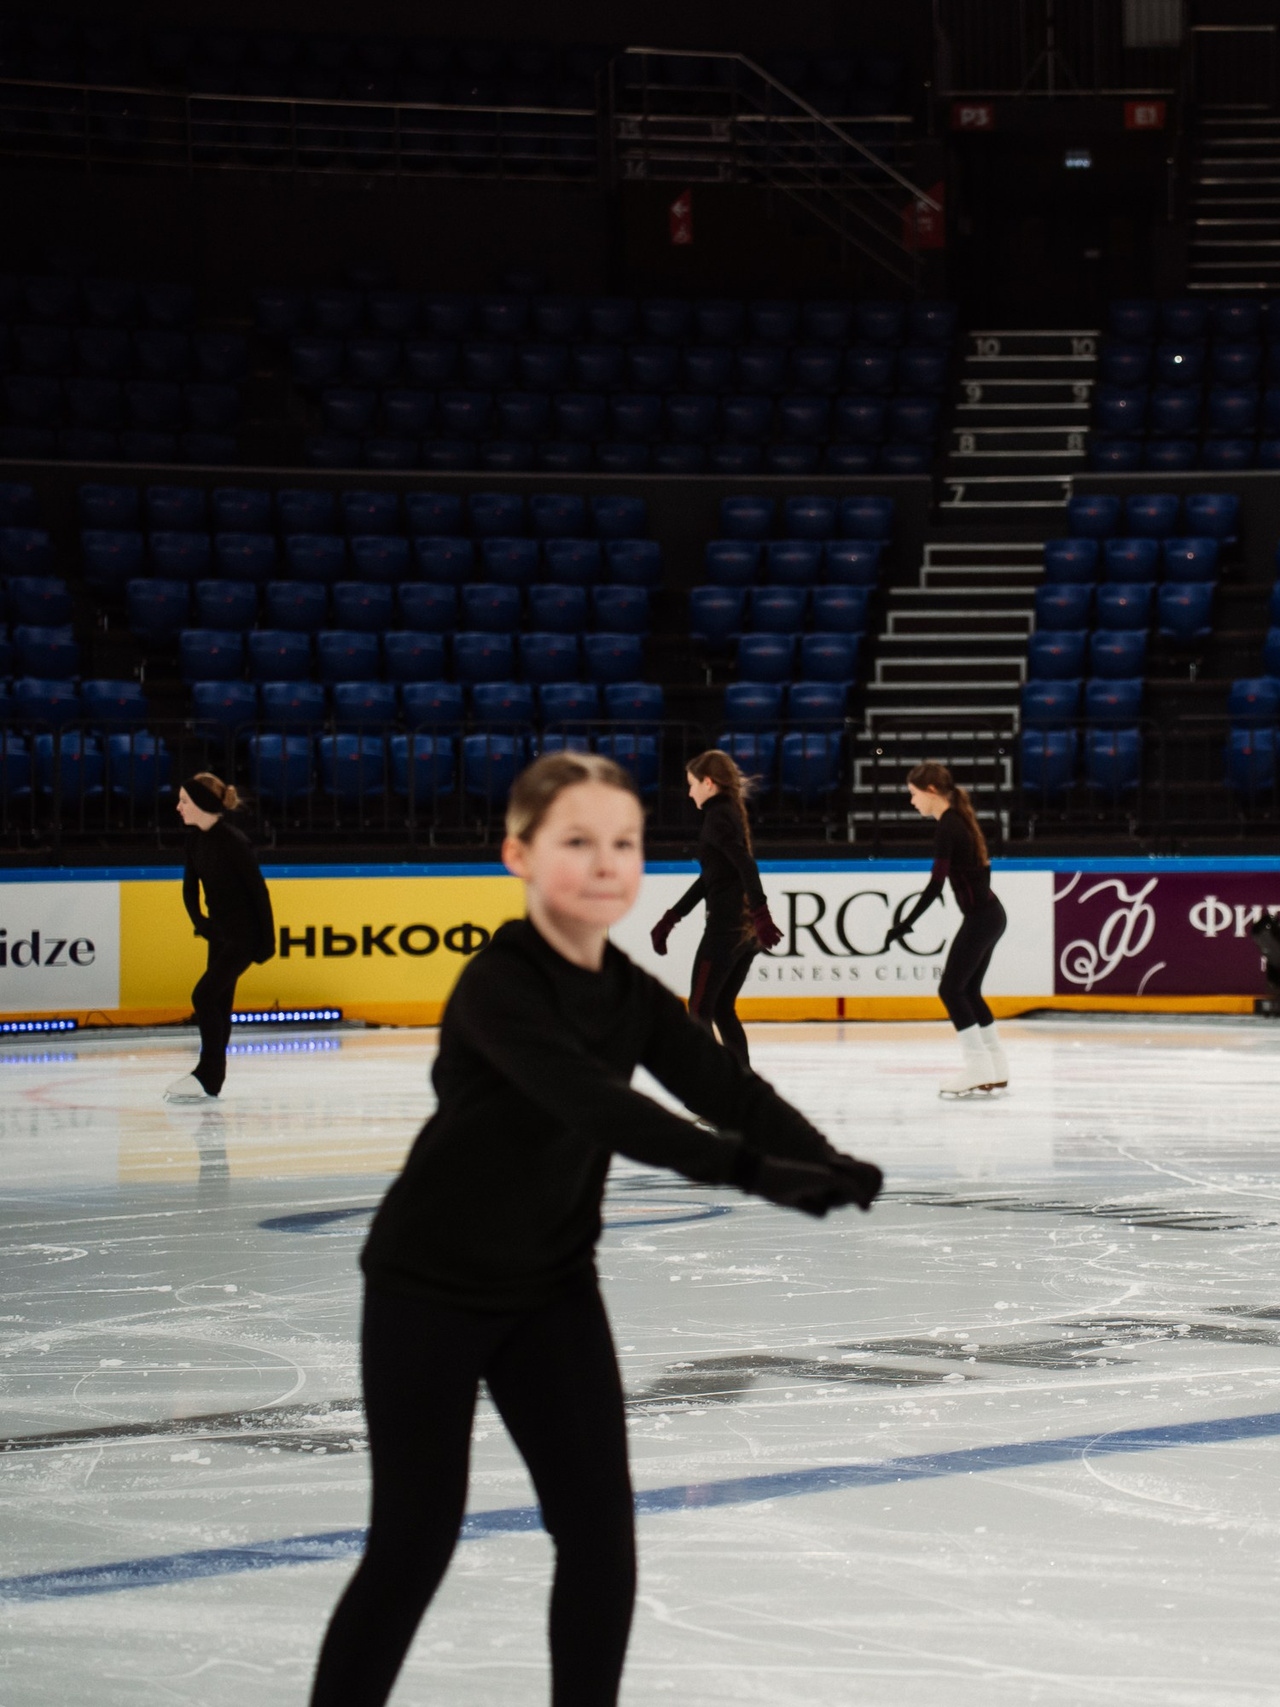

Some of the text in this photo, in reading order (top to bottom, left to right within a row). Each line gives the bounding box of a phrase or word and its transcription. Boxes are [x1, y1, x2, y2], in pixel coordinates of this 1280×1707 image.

[975, 337, 1000, 356] 10
[1070, 336, 1096, 356] 10
[965, 384, 983, 403] 9
[1072, 384, 1090, 403] 9
[950, 484, 966, 504] 7
[764, 890, 947, 958] RCC
[279, 922, 492, 958] НЬКОФ
[757, 967, 861, 981] SINESS
